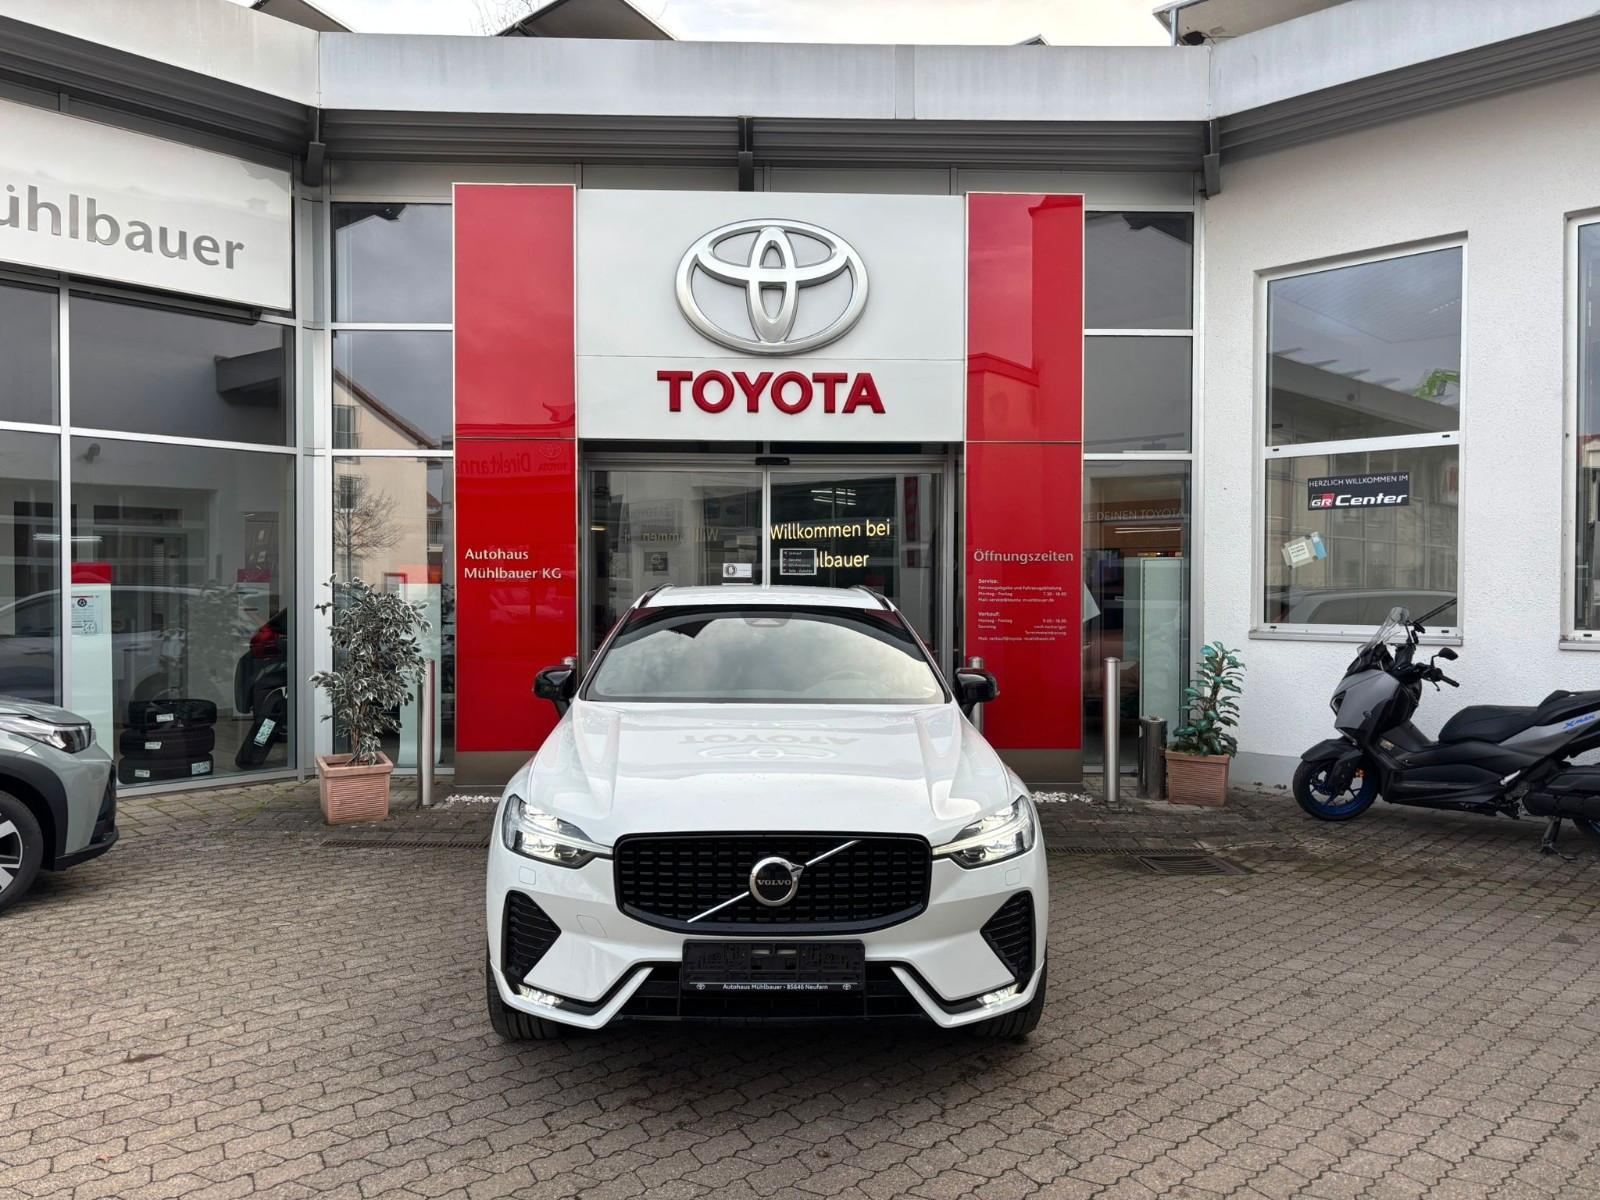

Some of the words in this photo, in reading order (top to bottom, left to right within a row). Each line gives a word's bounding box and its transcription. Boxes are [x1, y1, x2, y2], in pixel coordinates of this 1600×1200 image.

[657, 370, 886, 415] TOYOTA
[1309, 479, 1343, 488] HERZLICH
[1345, 475, 1397, 485] WILLKOMMEN
[1311, 499, 1332, 507] GR
[1335, 493, 1408, 506] Center
[1096, 510, 1137, 521] DEINEN
[1141, 507, 1184, 519] TOYOTA
[770, 522, 861, 540] Willkommen
[866, 518, 890, 537] bei
[464, 548, 529, 560] Autohaus
[973, 548, 1073, 564] Öffnungszeiten
[464, 567, 538, 579] Mühlbauer
[542, 568, 562, 579] KG
